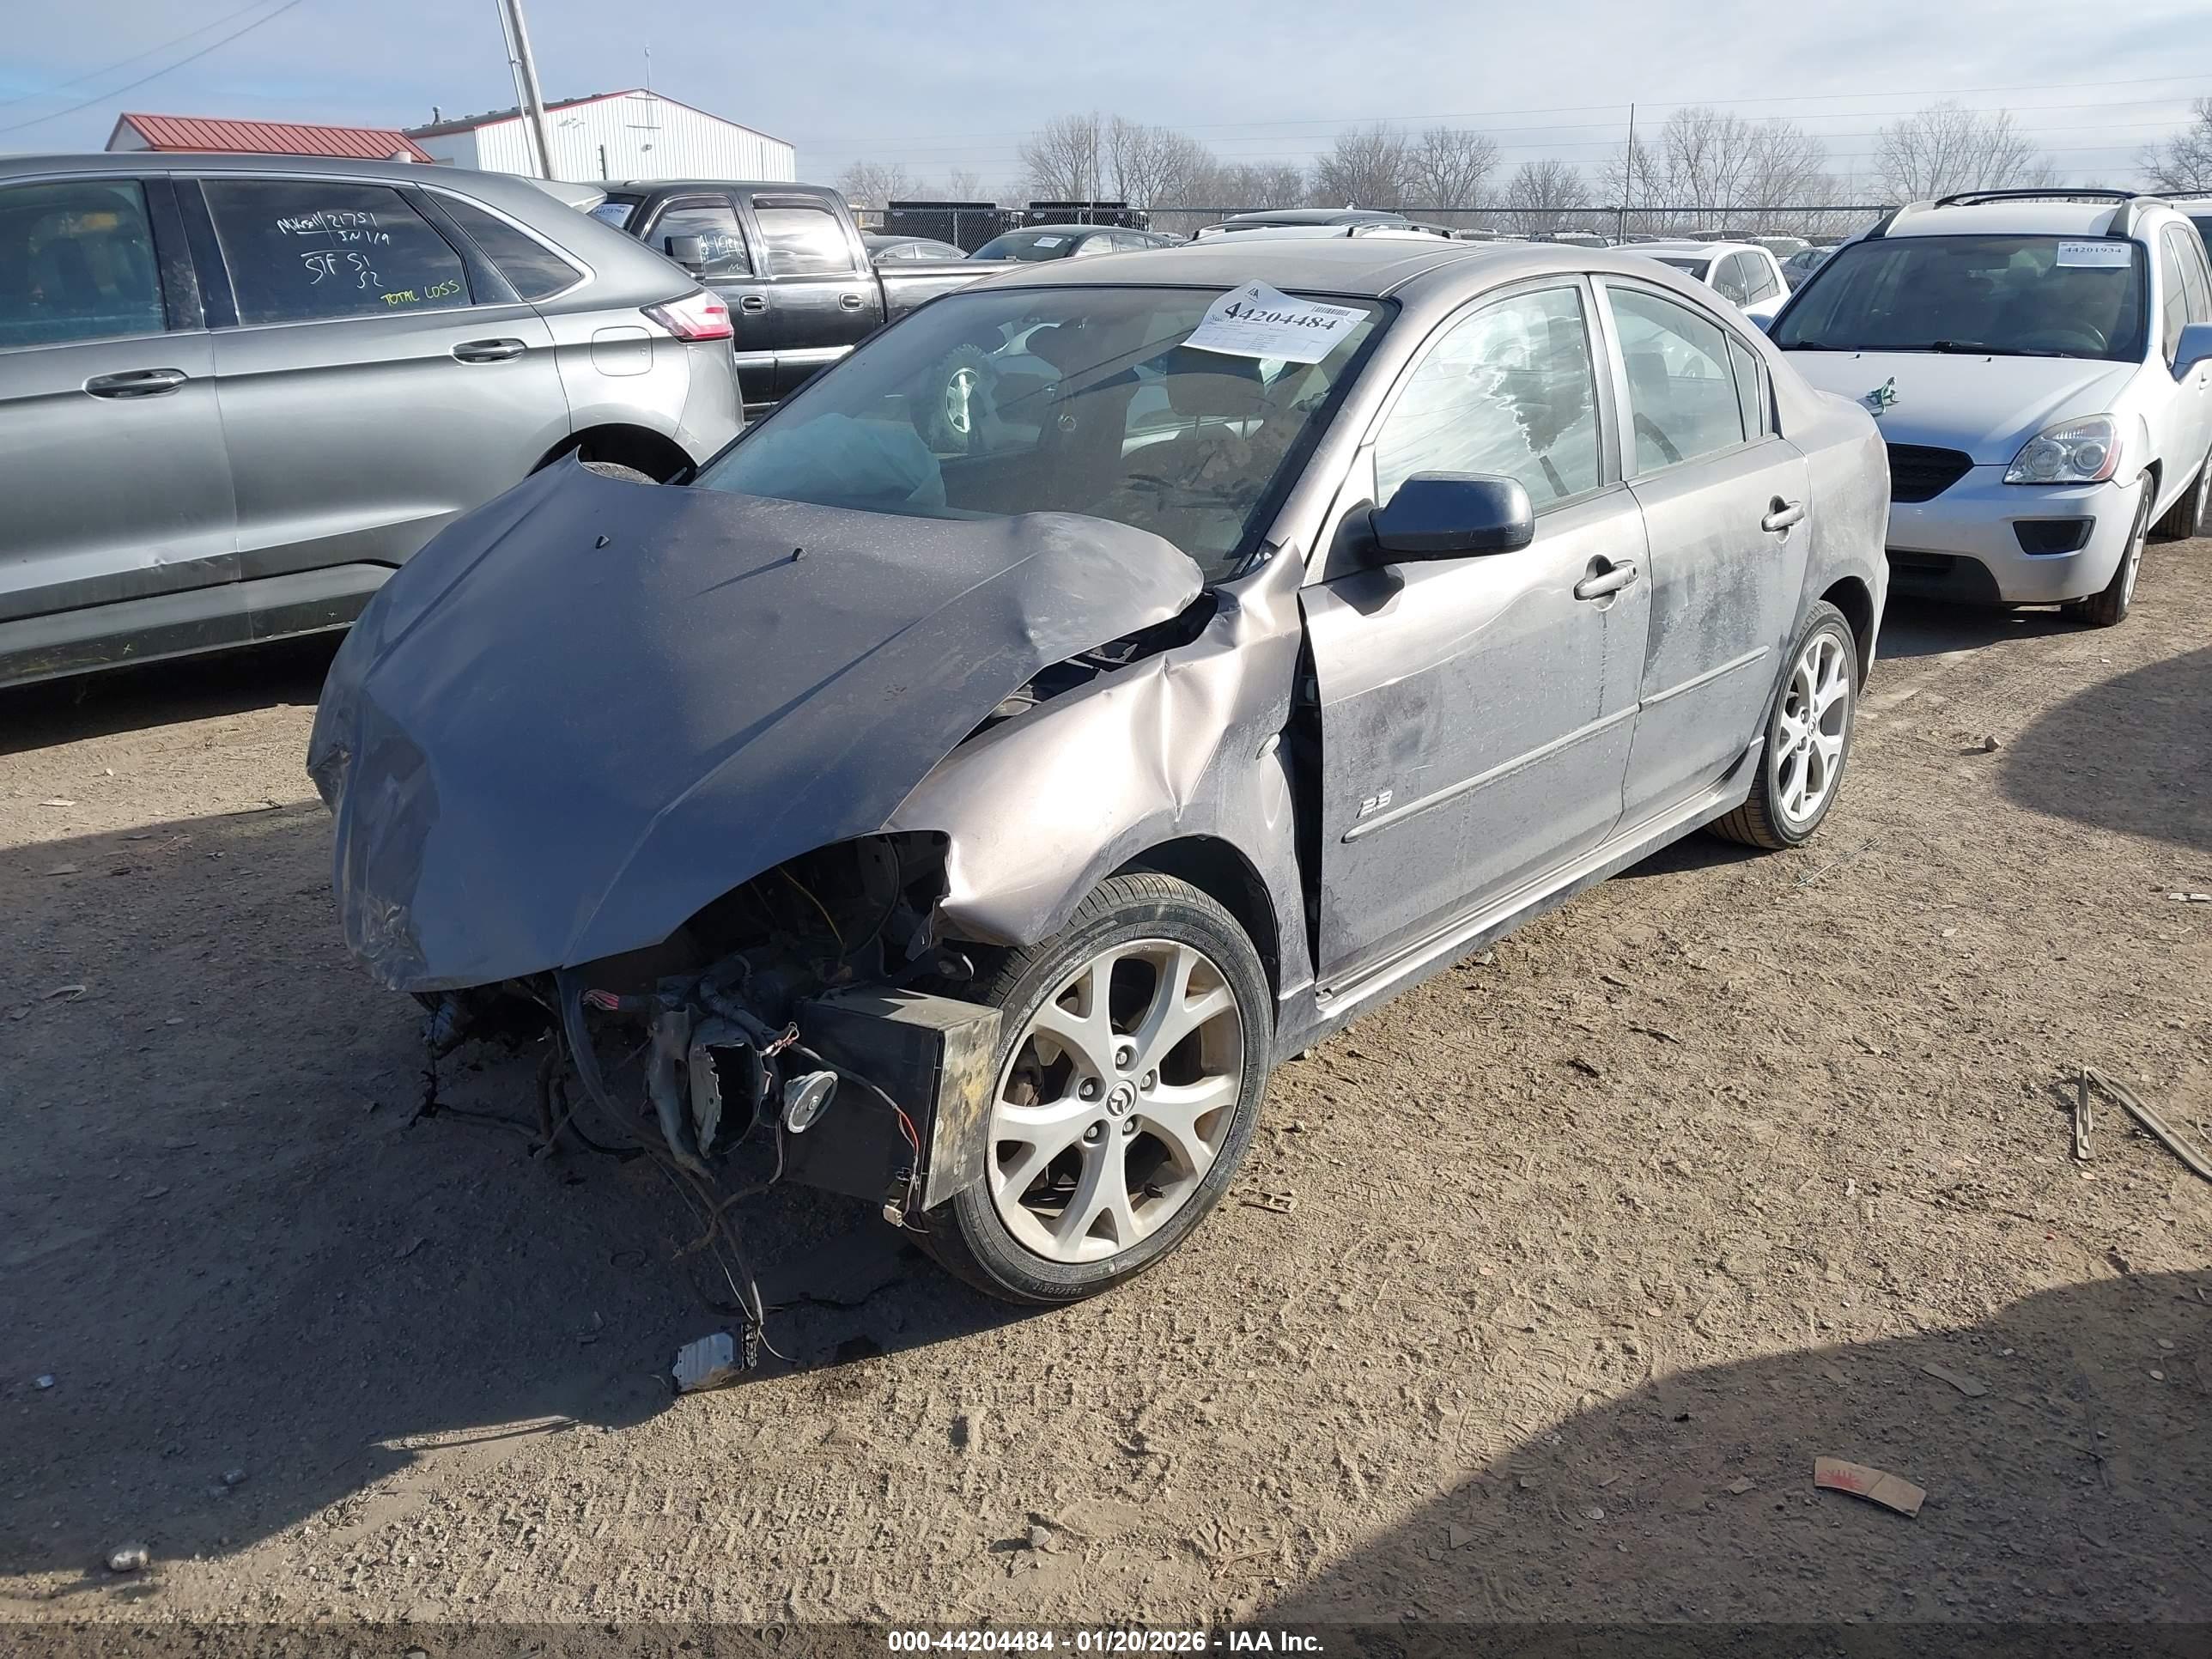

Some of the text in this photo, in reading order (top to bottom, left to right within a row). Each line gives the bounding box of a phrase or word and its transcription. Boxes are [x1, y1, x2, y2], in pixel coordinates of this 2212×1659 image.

[305, 253, 337, 285] STF
[380, 279, 460, 307] TOTAL LOSS
[1224, 301, 1338, 331] 44204484
